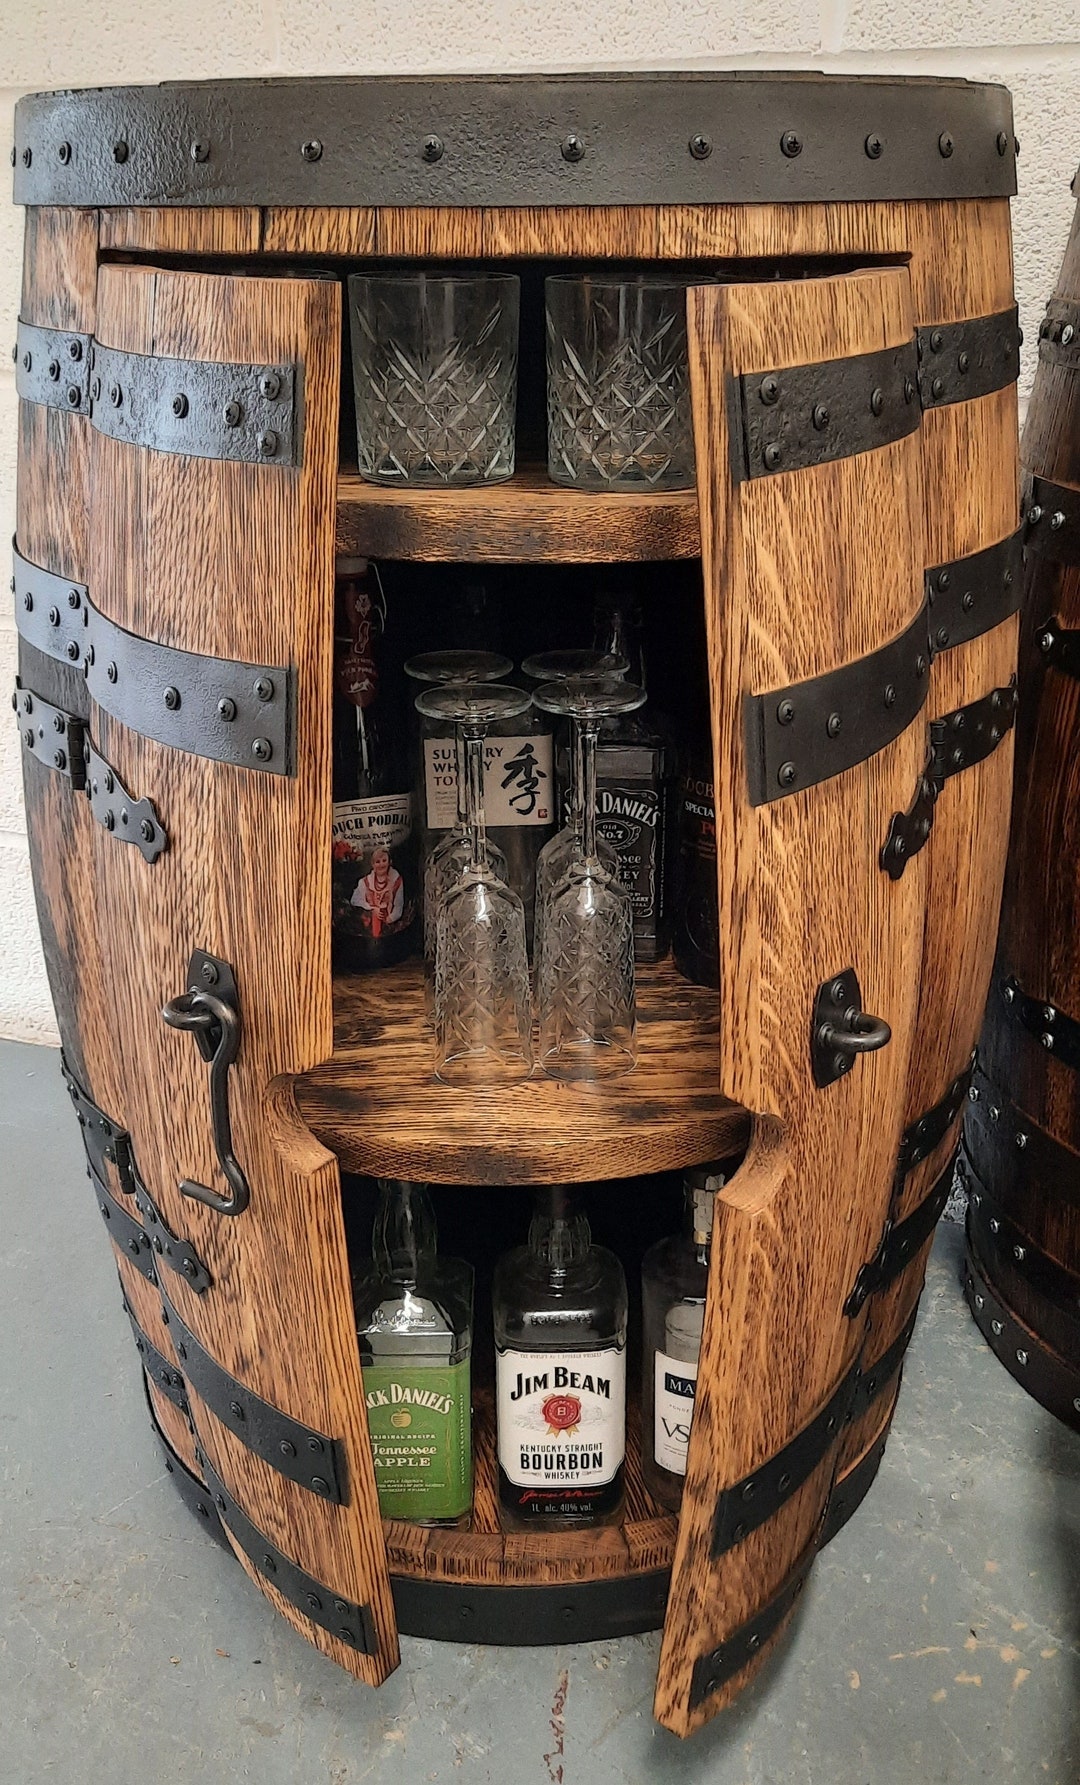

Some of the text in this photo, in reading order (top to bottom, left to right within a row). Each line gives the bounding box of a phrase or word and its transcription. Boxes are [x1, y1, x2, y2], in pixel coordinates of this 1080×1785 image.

[602, 791, 660, 828] DANIEL'S
[684, 800, 715, 818] SPECIA
[332, 817, 364, 837] DUCH
[510, 1366, 611, 1401] JIM BEAM
[390, 1383, 455, 1415] DANIEL'S
[371, 1442, 438, 1455] Tennessee
[520, 1442, 603, 1453] KENTUCKY STRAIGHT
[374, 1457, 432, 1467] APPLE
[520, 1451, 603, 1470] BOURBON
[544, 1471, 581, 1480] WHISKEY
[560, 1502, 578, 1512] 40%
